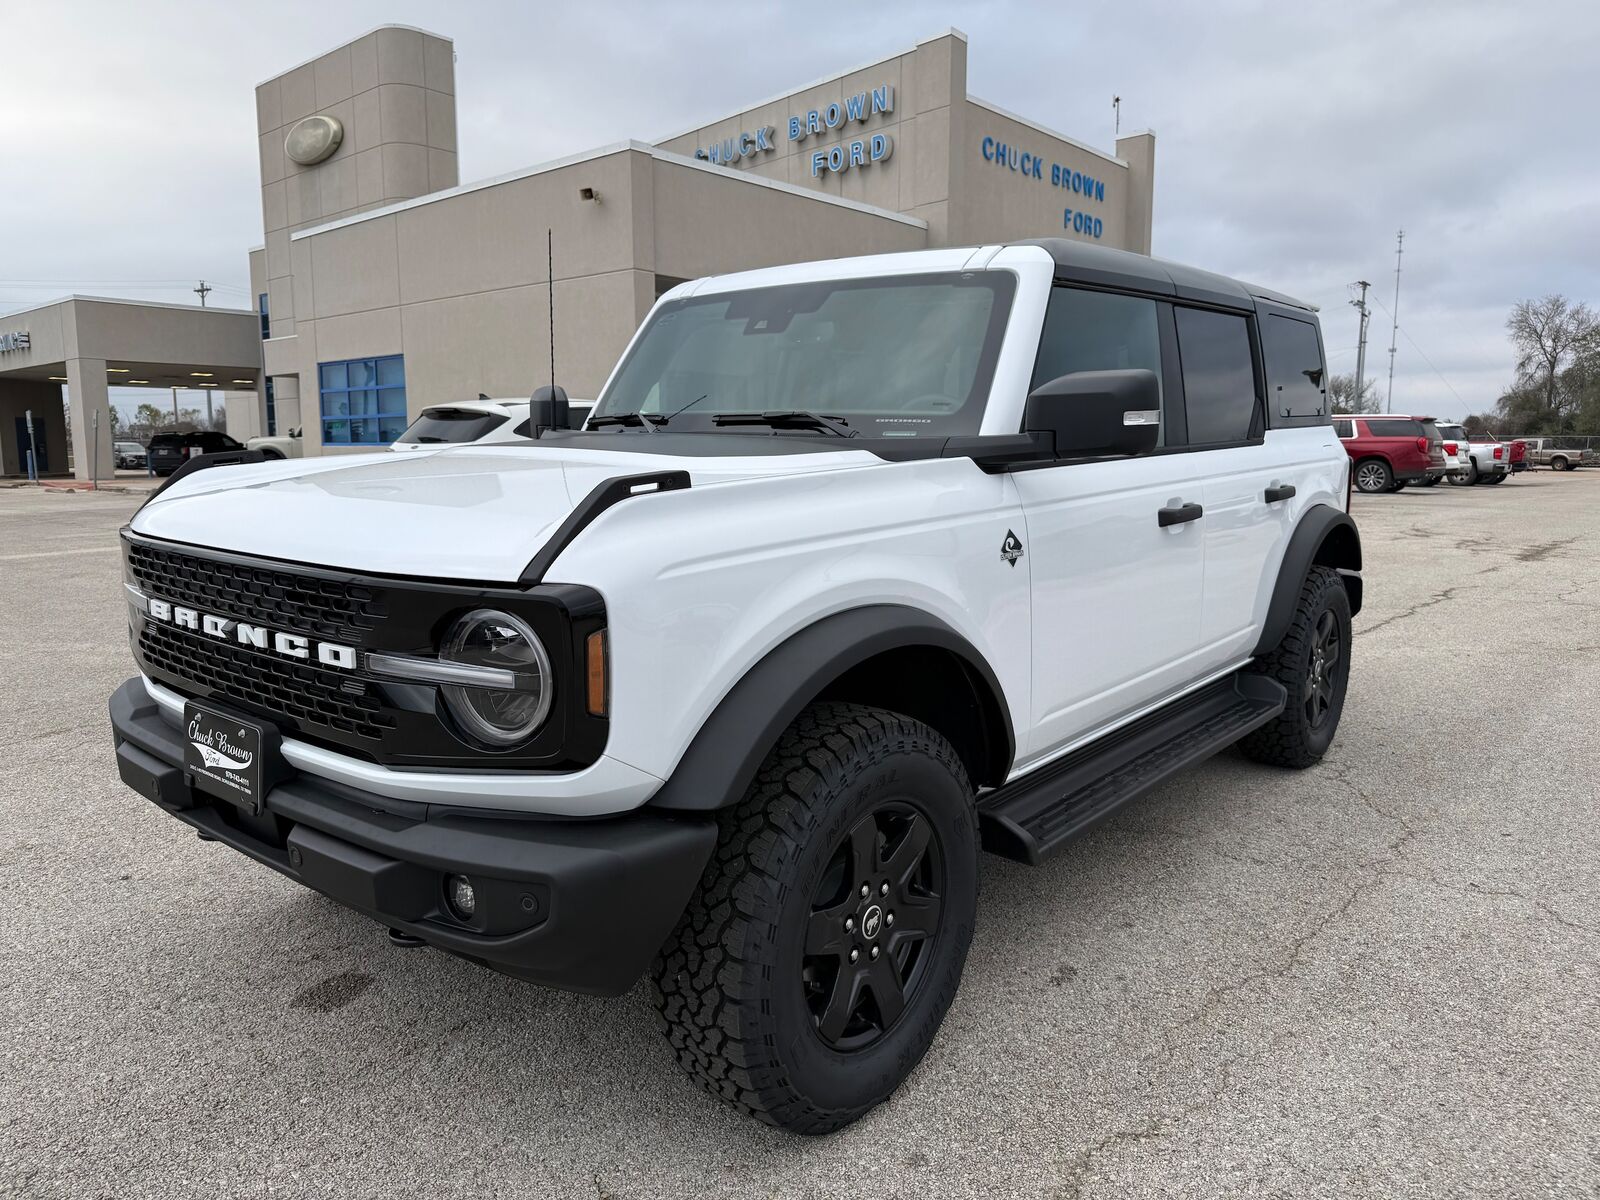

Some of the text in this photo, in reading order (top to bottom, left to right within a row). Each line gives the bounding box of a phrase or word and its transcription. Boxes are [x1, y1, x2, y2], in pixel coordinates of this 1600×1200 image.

[694, 85, 894, 165] CHUCK BROWN
[811, 134, 893, 178] FORD
[982, 136, 1104, 202] CHUCK BROWN
[1063, 208, 1103, 239] FORD
[150, 599, 357, 669] BRONCO
[188, 720, 252, 761] Chuck Brown
